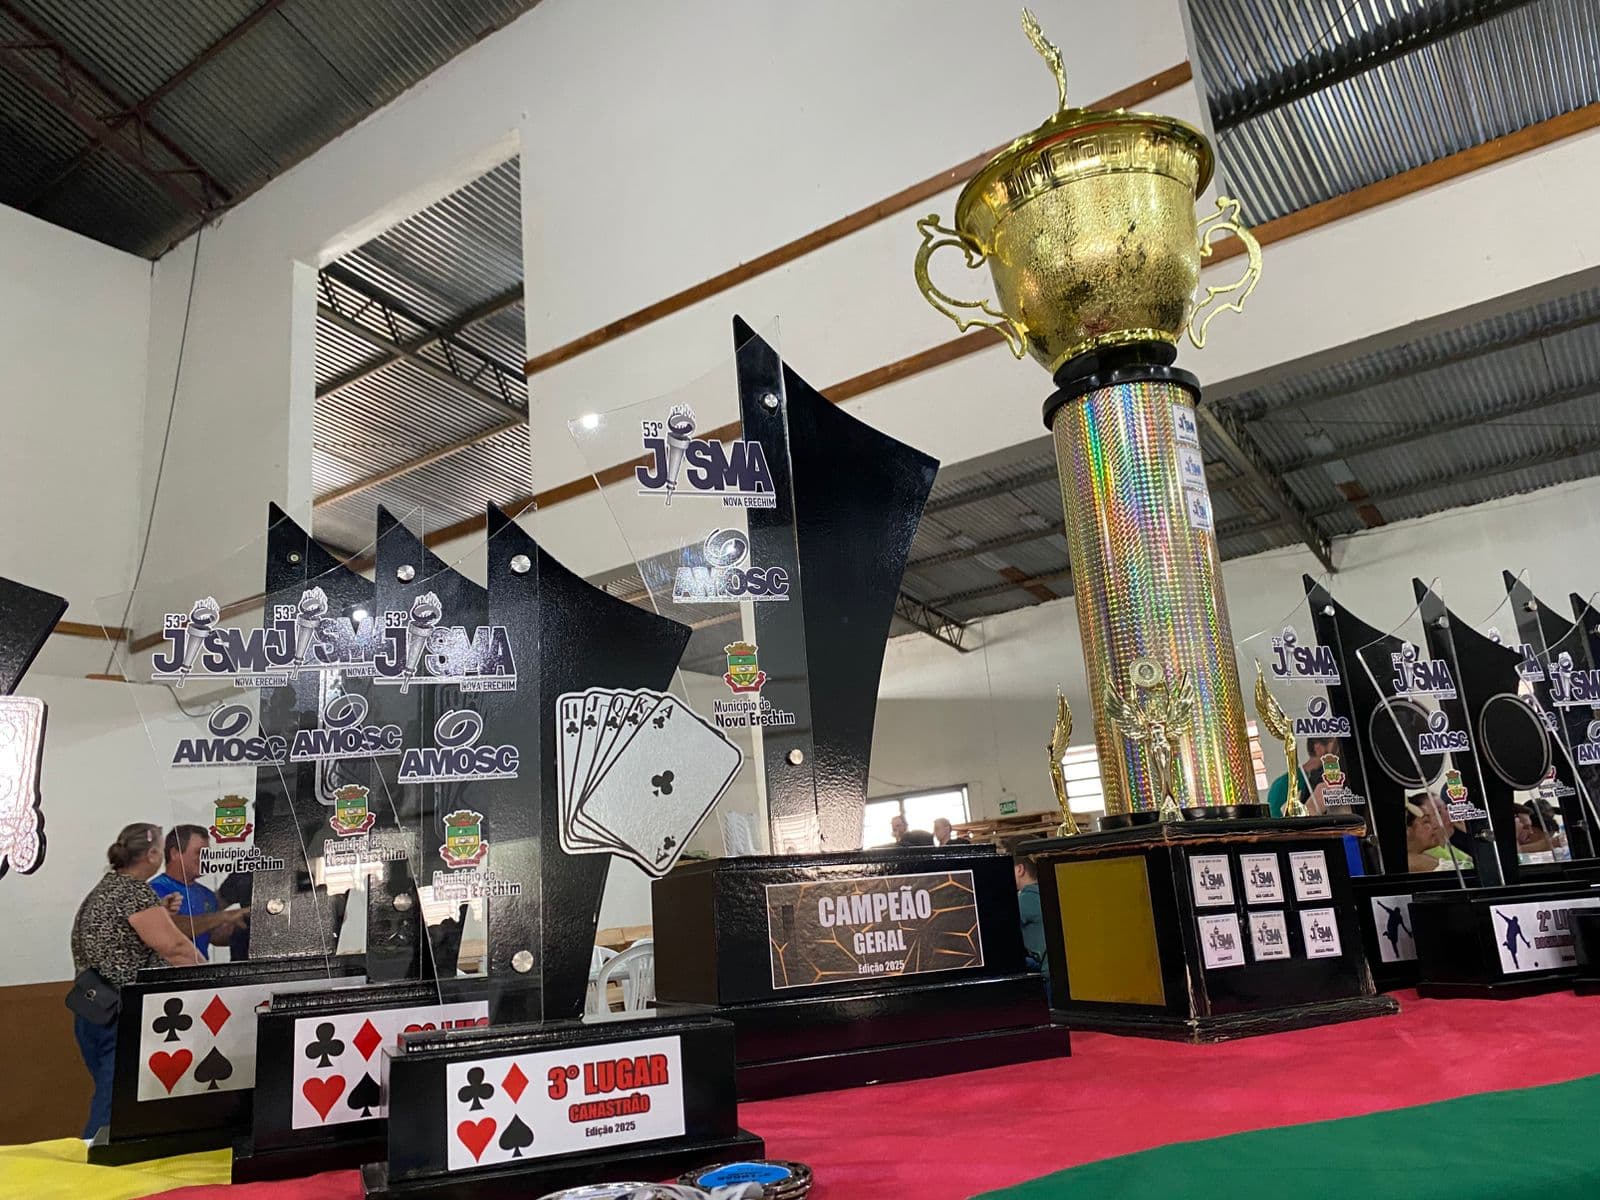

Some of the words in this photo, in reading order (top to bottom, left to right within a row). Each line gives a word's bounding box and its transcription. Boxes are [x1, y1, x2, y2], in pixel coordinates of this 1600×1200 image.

[643, 422, 663, 437] 53º
[724, 497, 743, 507] NOVA
[744, 497, 776, 508] ERECHIM
[673, 567, 789, 597] AMOSC
[275, 606, 295, 620] 53º
[385, 612, 407, 627] 53º
[165, 615, 186, 628] 53º
[347, 668, 367, 677] NOVA
[235, 677, 254, 687] NOVA
[255, 677, 287, 687] ERECHIM
[462, 681, 482, 691] NOVA
[483, 680, 516, 691] ERECHIM
[587, 696, 600, 712] J
[612, 696, 624, 718] Q
[635, 697, 648, 714] K
[660, 704, 673, 720] A
[714, 700, 758, 714] Município
[759, 698, 770, 711] de
[716, 713, 746, 727] Nova
[750, 711, 794, 726] Erechim
[1296, 717, 1350, 735] AMOSC
[291, 725, 402, 756] AMOSC
[1420, 731, 1469, 751] AMOSC
[173, 736, 287, 763] AMOSC
[400, 746, 519, 776] AMOSC
[201, 846, 247, 862] Município
[248, 845, 260, 858] de
[200, 860, 235, 874] Nova
[236, 858, 284, 872] Erechim
[483, 870, 496, 881] de
[471, 880, 521, 897] Erechim
[818, 886, 932, 927] CAMPEÃO
[853, 930, 907, 955] GERAL
[858, 961, 884, 975] Edição
[885, 960, 905, 972] 2025
[548, 1065, 580, 1100] 3º
[584, 1054, 669, 1096] LUGAR
[569, 1093, 651, 1123] CANASTRÃO
[585, 1123, 613, 1138] Edição
[615, 1120, 636, 1134] 2025
